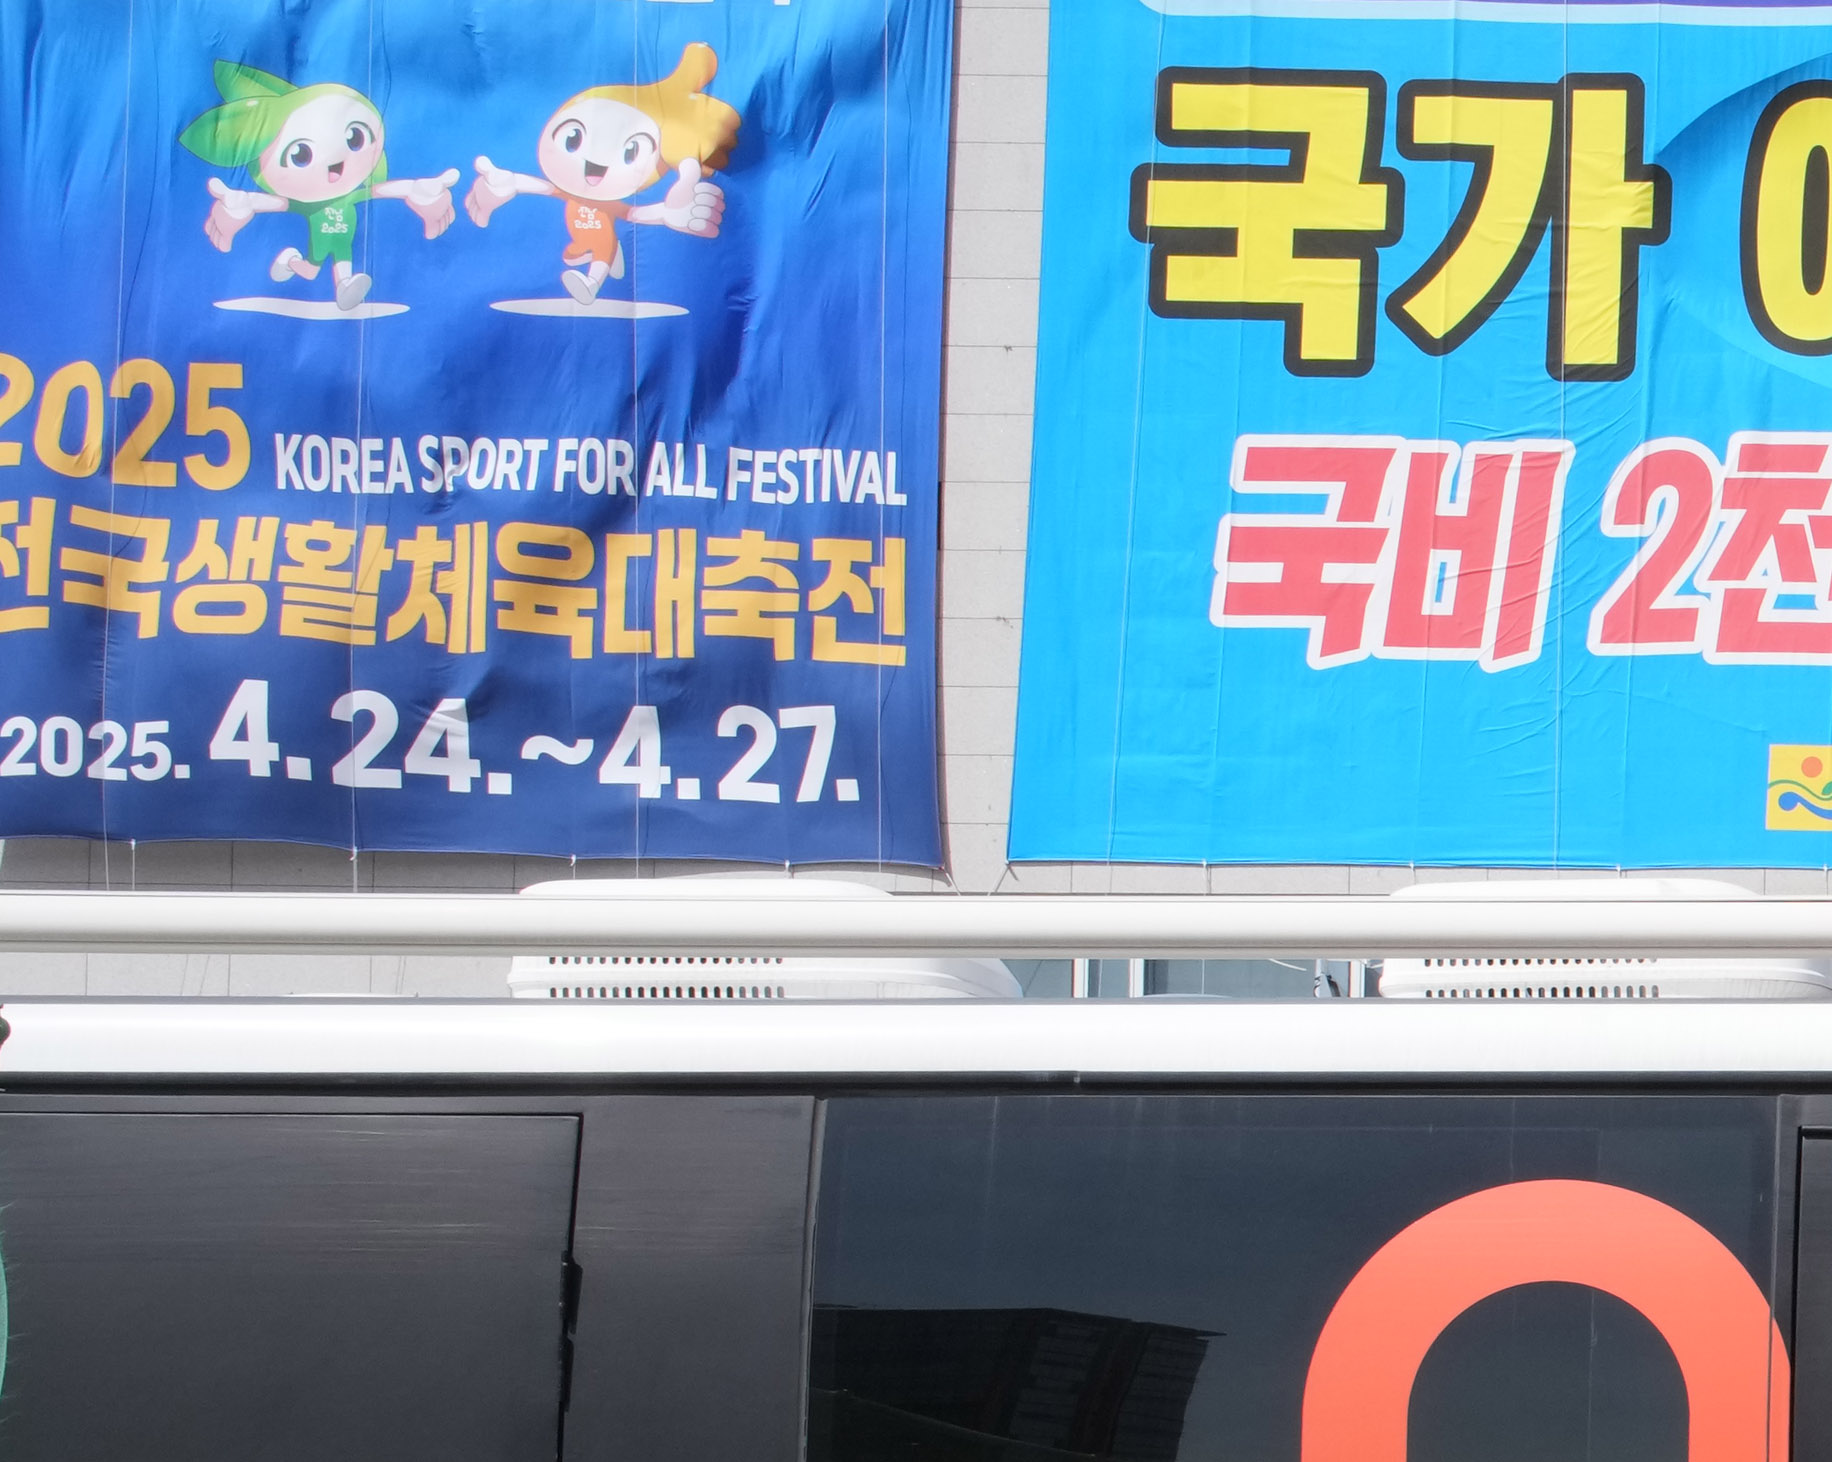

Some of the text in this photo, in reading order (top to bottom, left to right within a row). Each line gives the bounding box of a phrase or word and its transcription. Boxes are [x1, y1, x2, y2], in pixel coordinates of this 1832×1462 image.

[1131, 68, 1670, 380] 국가
[275, 433, 411, 494] KOREA
[418, 435, 549, 494] SPORT
[554, 438, 636, 496] FOR
[646, 441, 718, 499] ALL
[727, 446, 908, 506] FESTIVAL
[1214, 435, 1573, 668] 국비
[0, 716, 190, 781] 2025.
